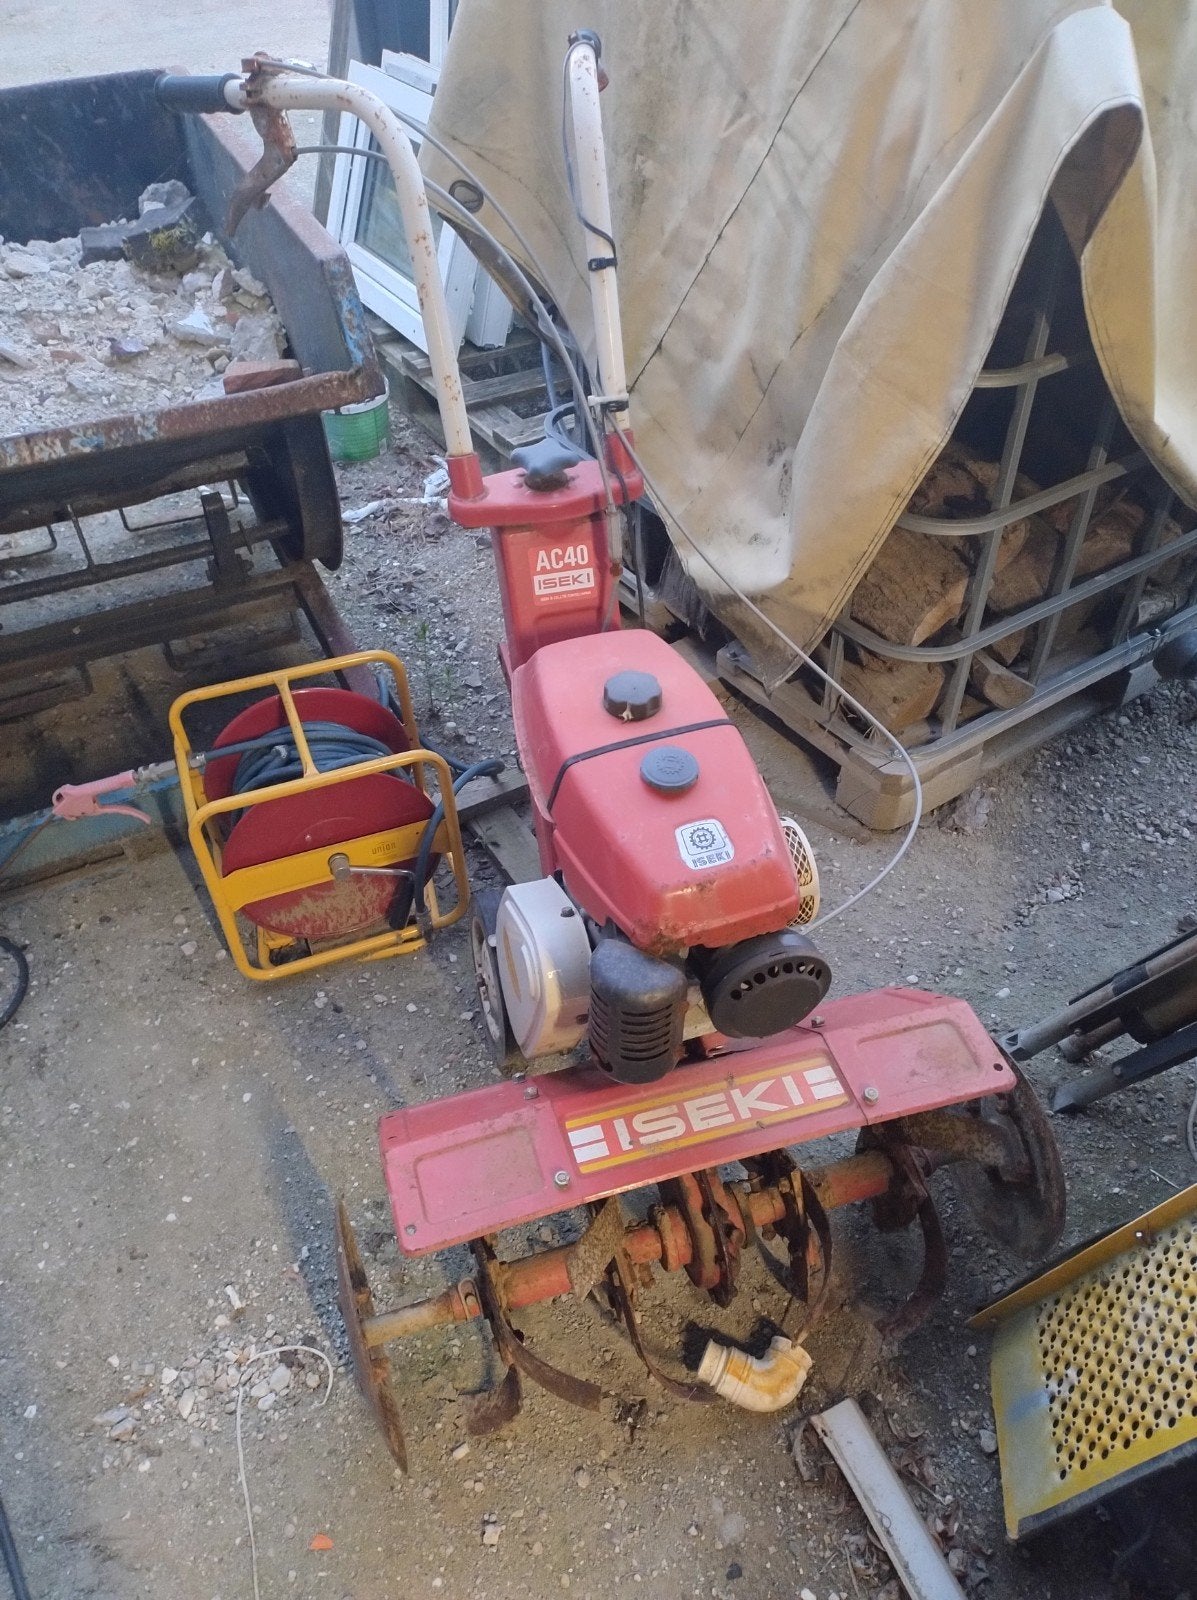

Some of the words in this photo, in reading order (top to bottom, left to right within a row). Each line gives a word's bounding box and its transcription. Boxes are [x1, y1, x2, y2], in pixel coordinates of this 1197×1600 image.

[536, 545, 589, 571] AC40
[538, 572, 591, 590] ISEKI
[692, 850, 731, 868] ISEKI
[613, 1075, 804, 1151] ISEKI
